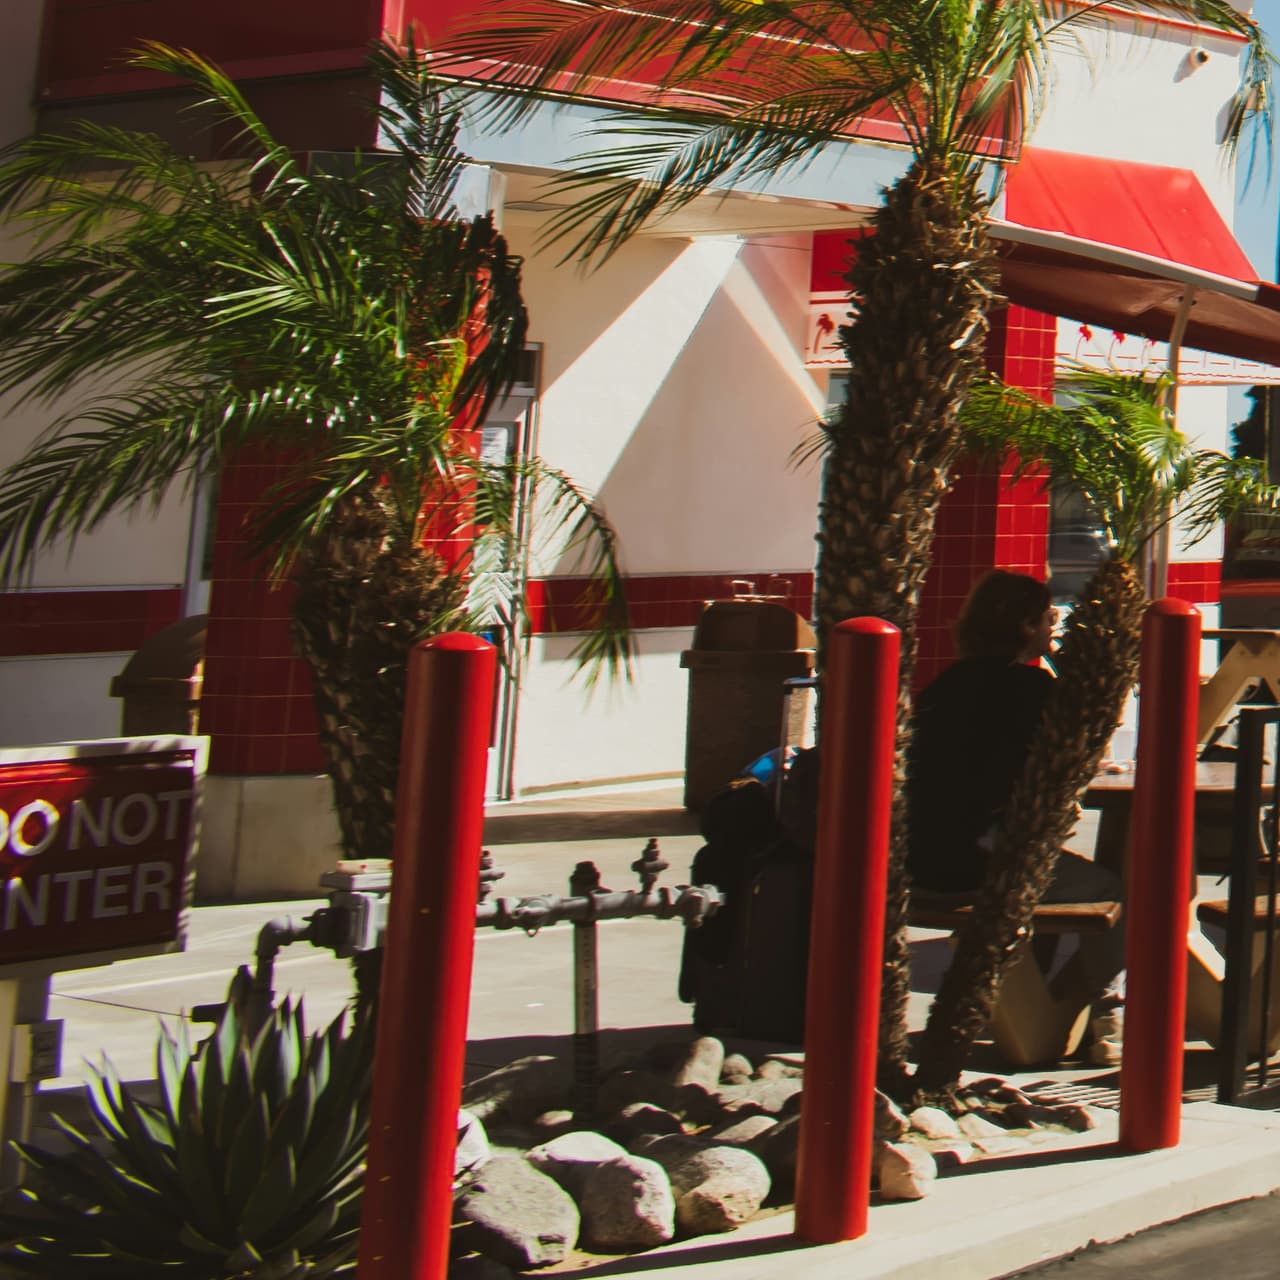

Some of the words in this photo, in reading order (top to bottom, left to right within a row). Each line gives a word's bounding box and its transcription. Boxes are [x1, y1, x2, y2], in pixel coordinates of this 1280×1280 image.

[0, 799, 60, 856] O
[67, 790, 192, 850] NOT
[0, 861, 173, 931] NTER
